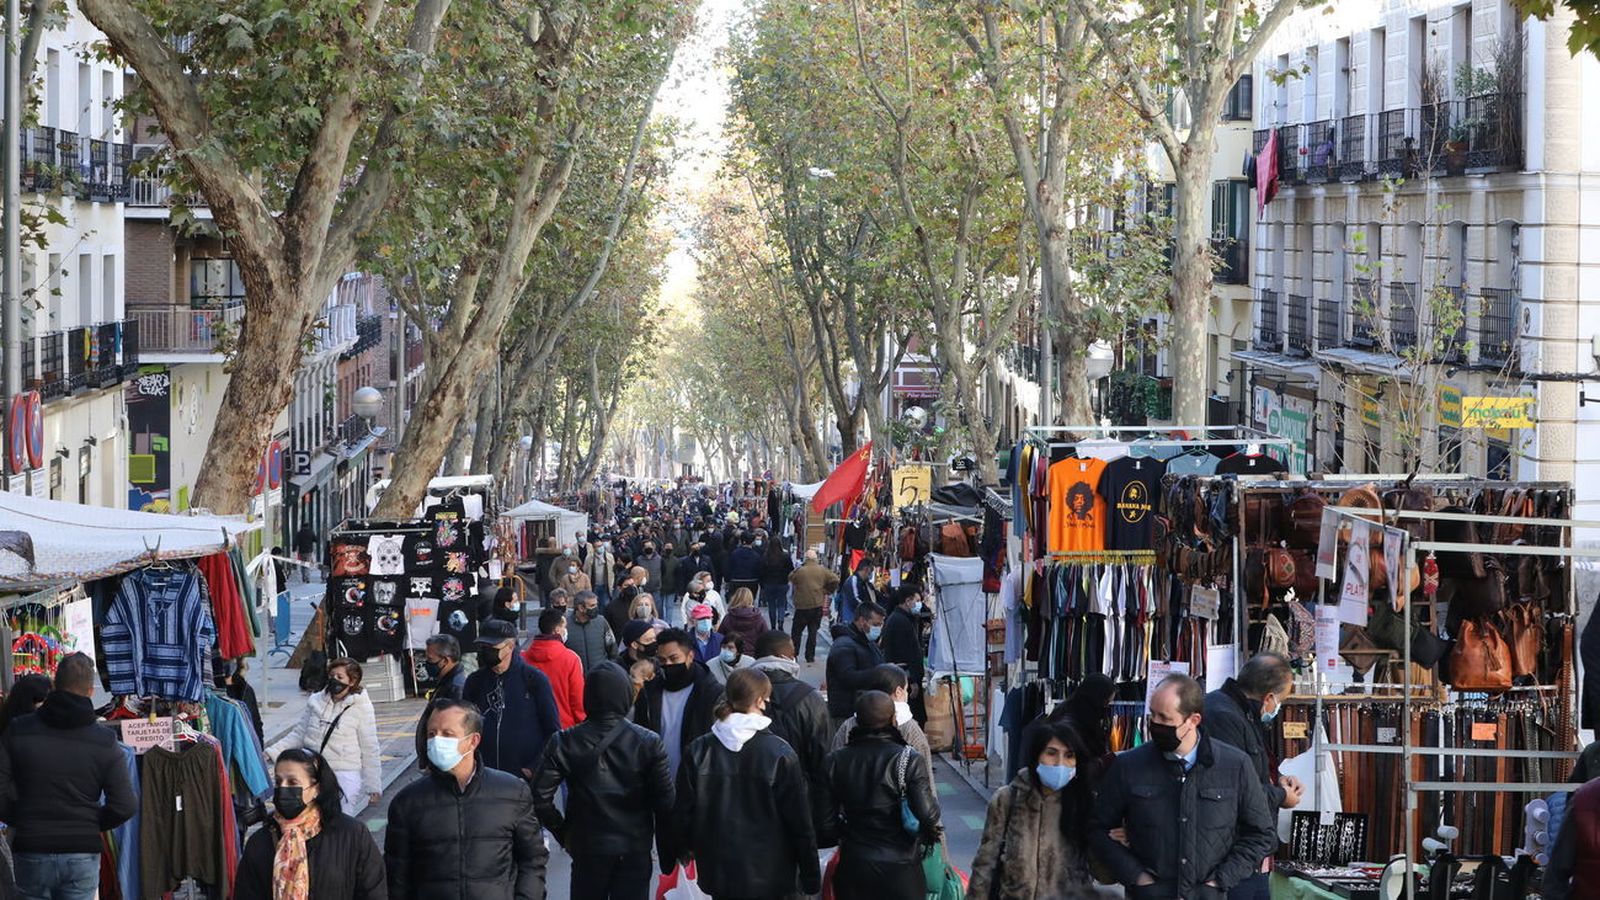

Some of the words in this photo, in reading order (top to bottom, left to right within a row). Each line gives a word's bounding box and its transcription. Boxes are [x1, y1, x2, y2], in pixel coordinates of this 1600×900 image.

[294, 453, 310, 473] P
[899, 476, 919, 507] 5
[127, 728, 161, 736] TARJETAS
[128, 721, 169, 729] ACEPTAMOS
